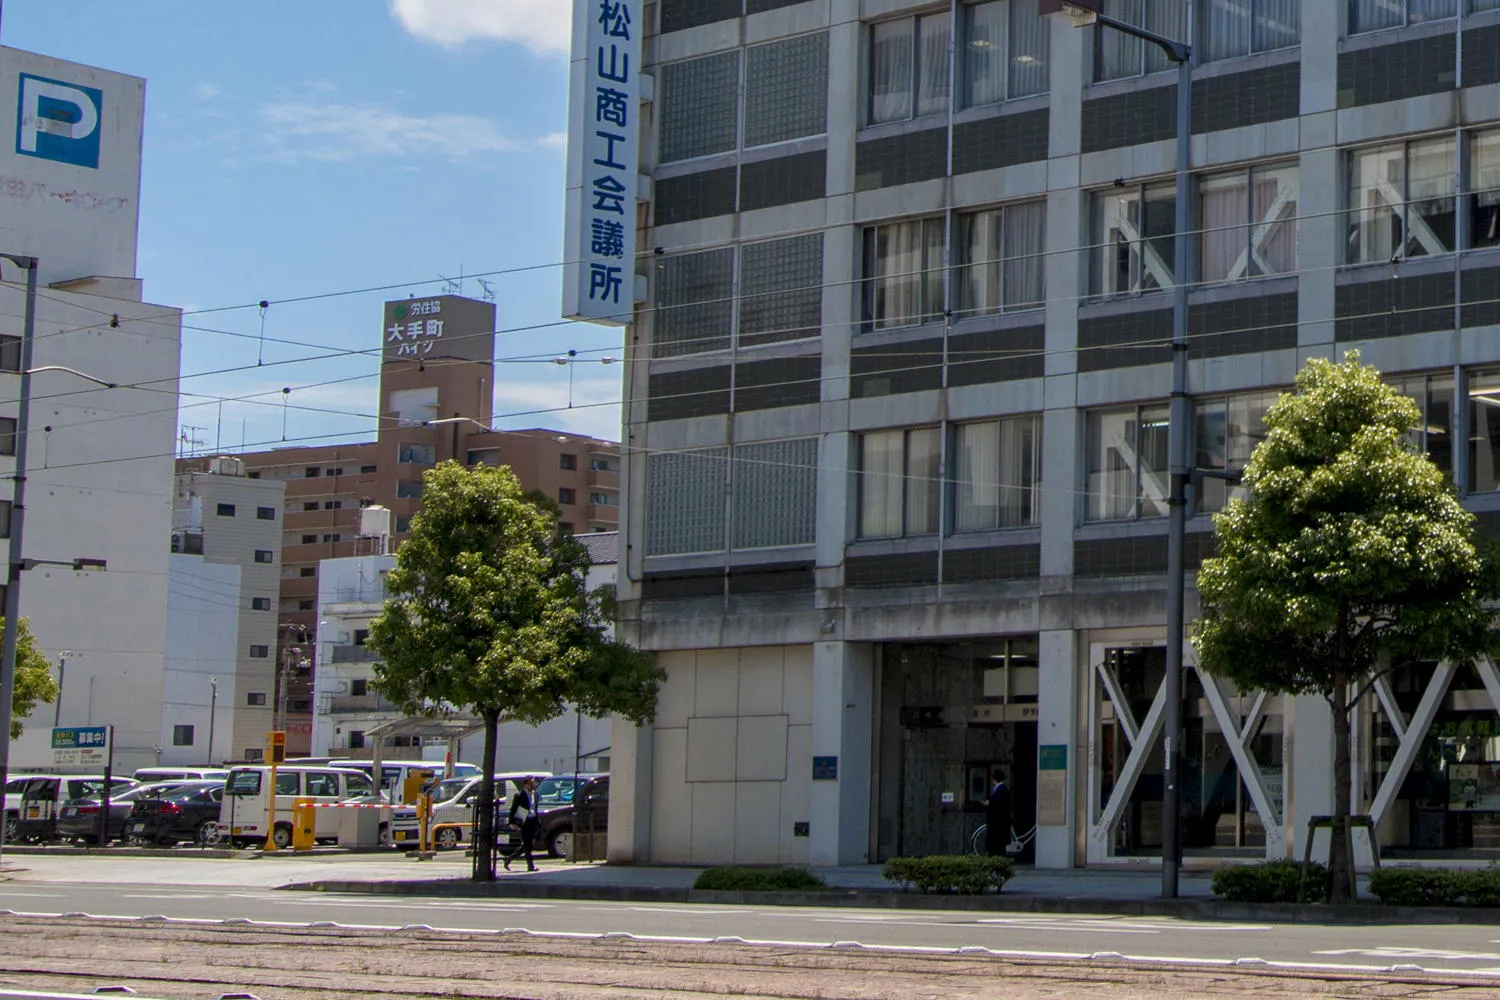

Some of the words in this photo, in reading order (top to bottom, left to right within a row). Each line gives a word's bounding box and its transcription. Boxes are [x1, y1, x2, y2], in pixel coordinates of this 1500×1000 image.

[20, 77, 98, 153] P
[387, 319, 444, 342] 大手町
[398, 339, 434, 355] ハイツ
